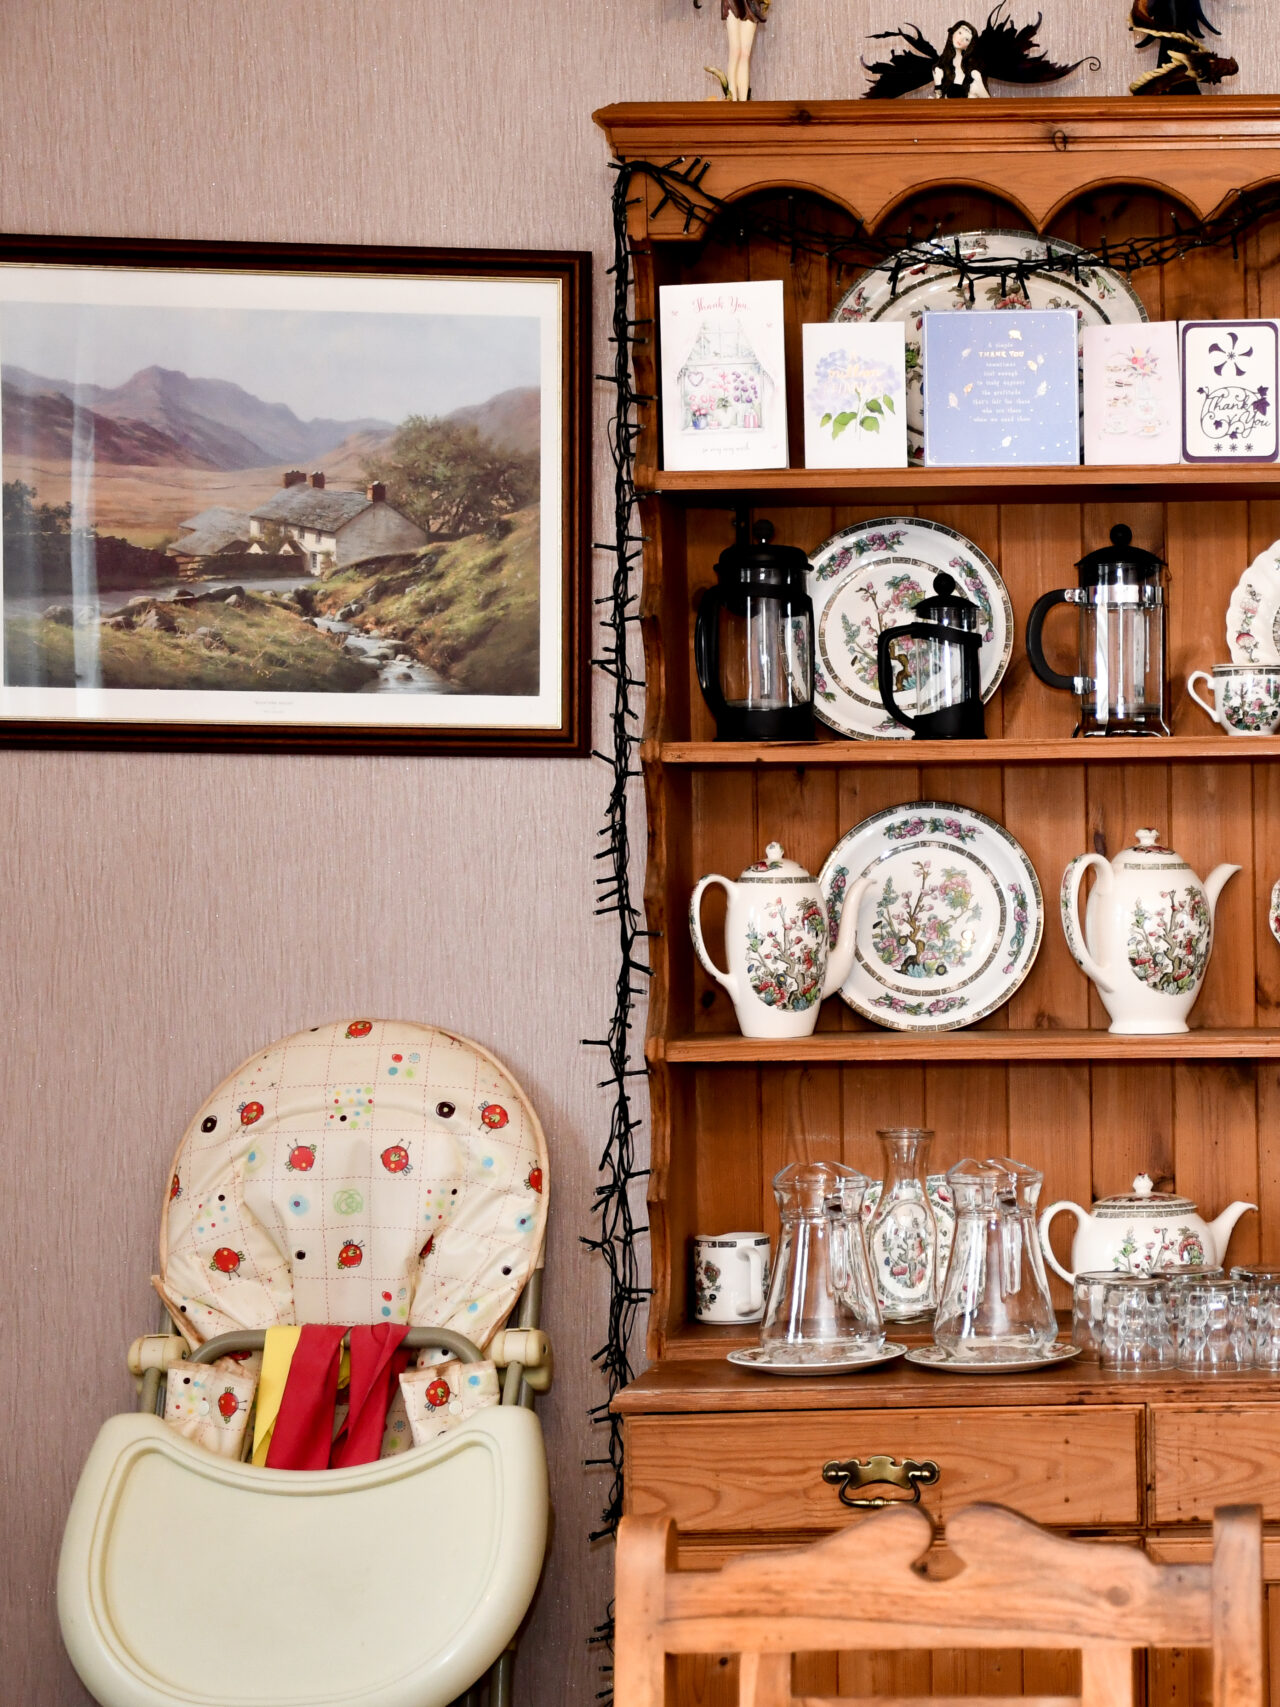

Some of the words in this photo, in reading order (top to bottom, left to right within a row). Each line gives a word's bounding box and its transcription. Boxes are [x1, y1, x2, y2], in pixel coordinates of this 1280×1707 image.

[692, 295, 724, 313] Thank
[728, 295, 750, 314] You
[1008, 350, 1025, 358] YOU
[993, 388, 1021, 396] gratitude
[1206, 393, 1251, 411] Thank
[1238, 410, 1271, 439] You
